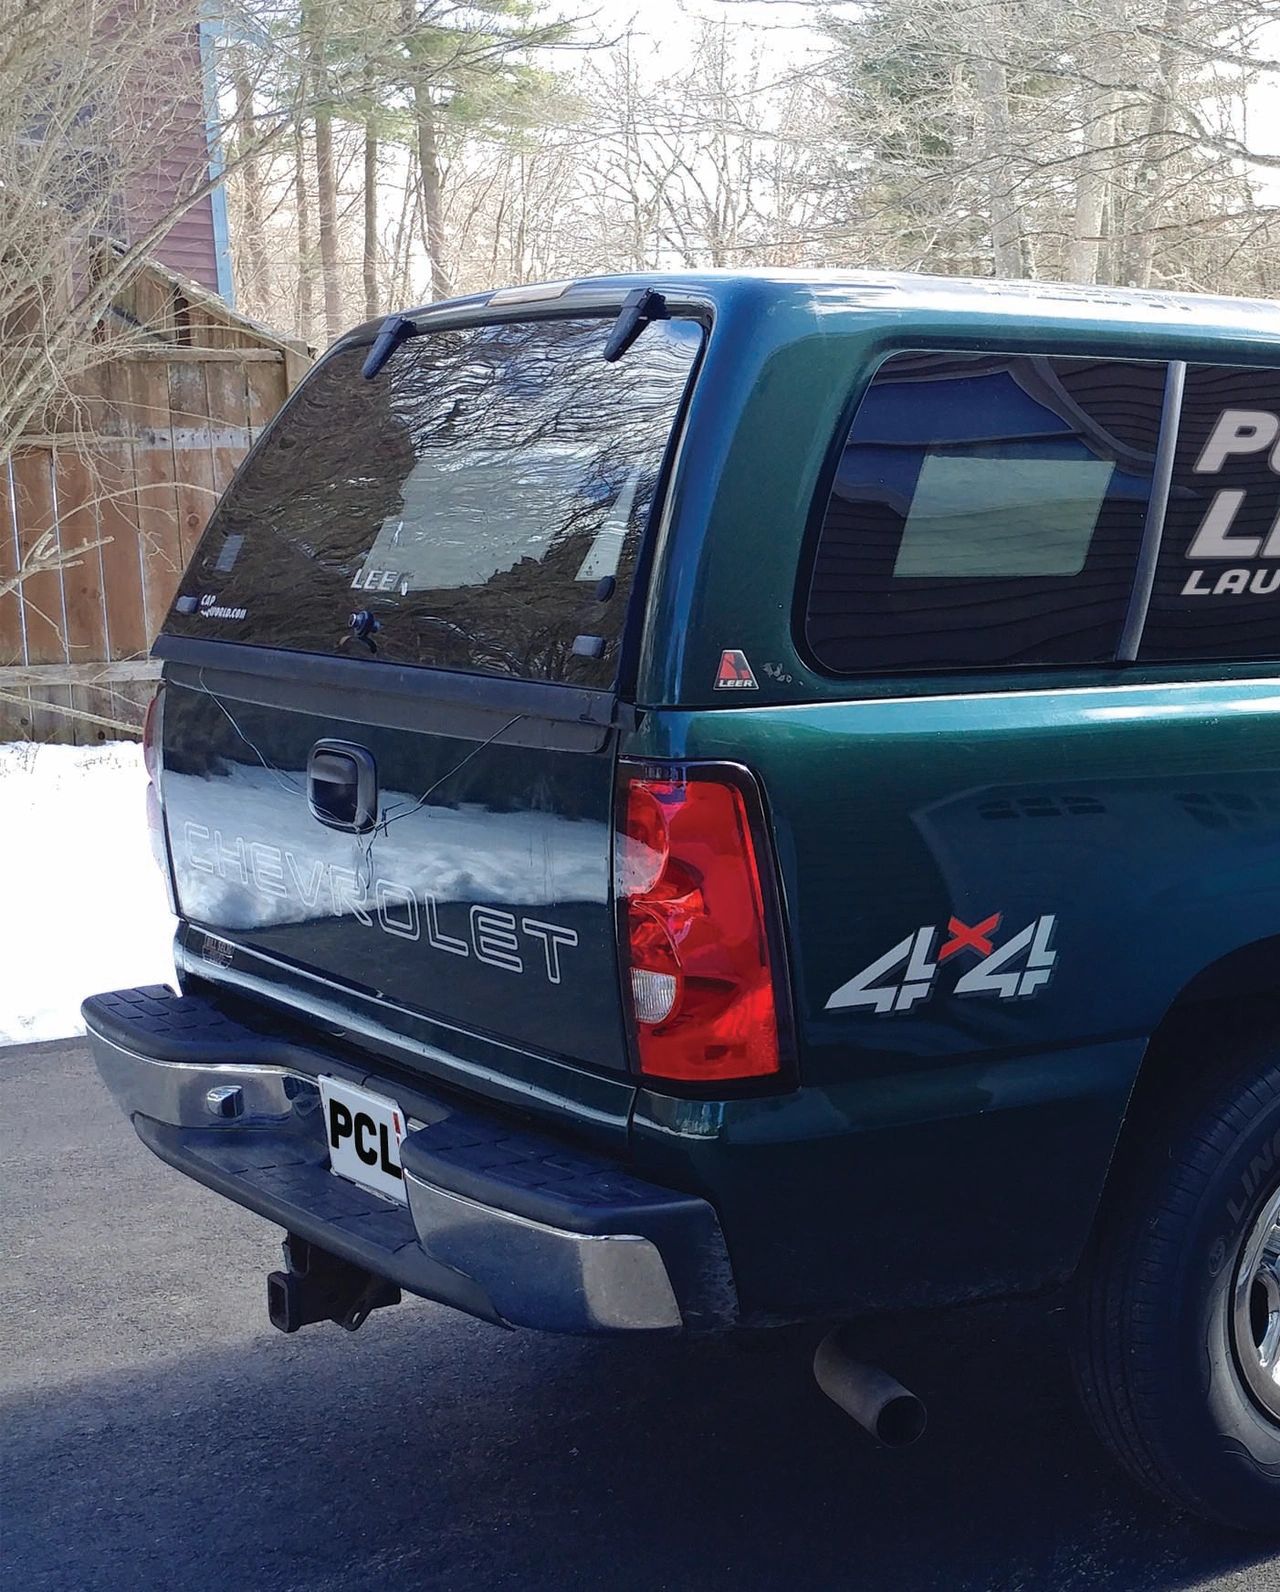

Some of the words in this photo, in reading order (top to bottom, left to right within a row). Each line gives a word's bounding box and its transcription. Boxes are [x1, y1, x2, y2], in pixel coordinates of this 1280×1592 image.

[350, 568, 408, 596] LEE
[717, 679, 754, 688] LEER
[183, 820, 579, 985] CHEVROLET
[329, 1098, 403, 1180] PCL
